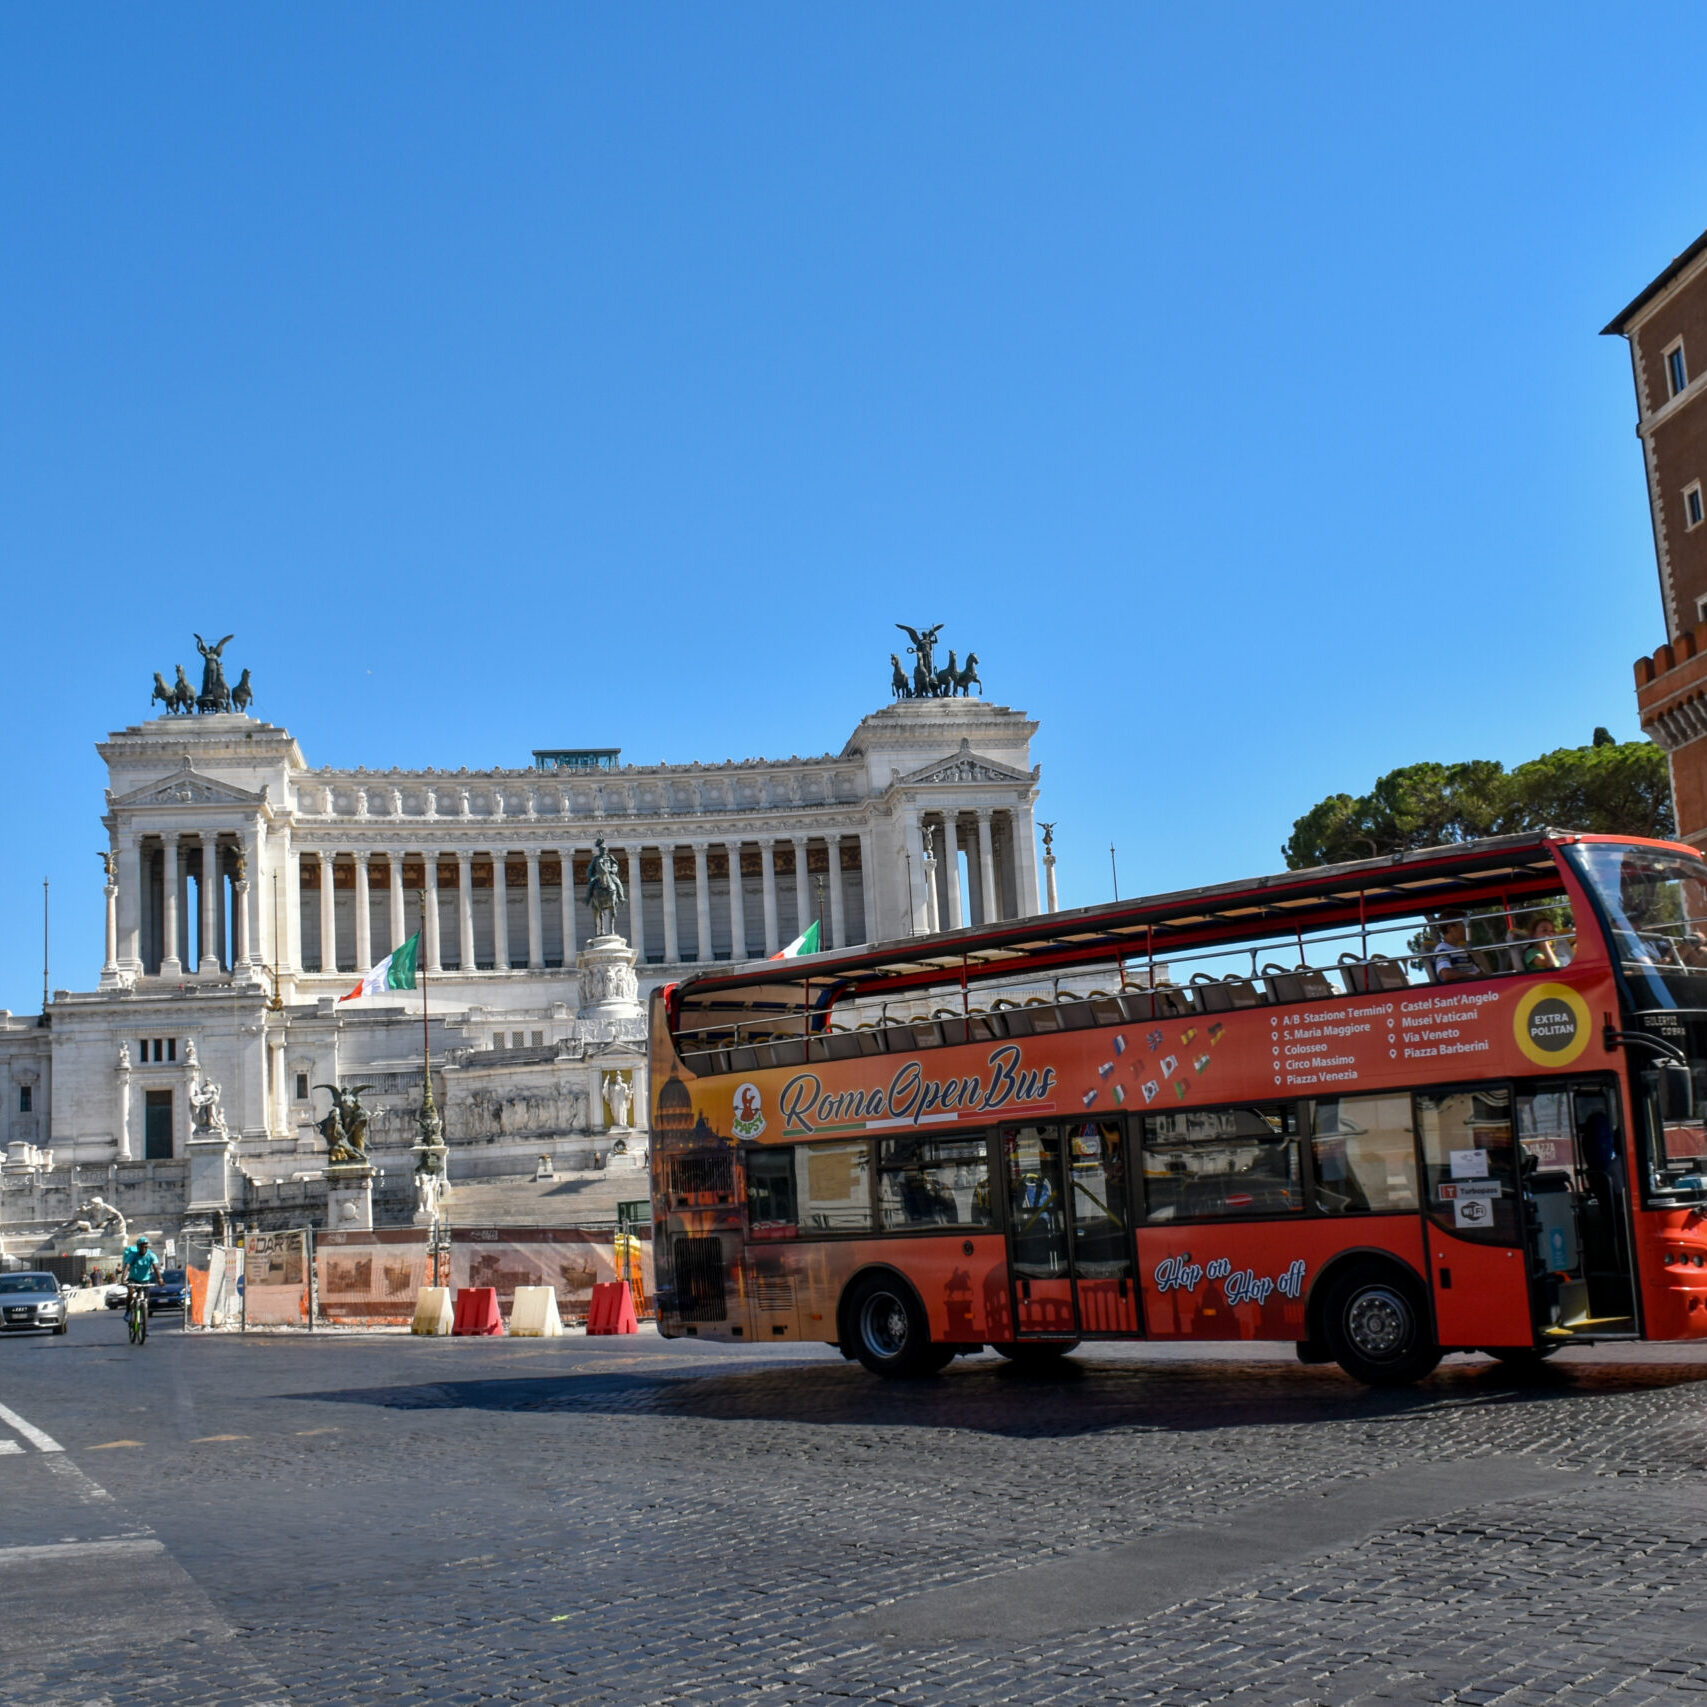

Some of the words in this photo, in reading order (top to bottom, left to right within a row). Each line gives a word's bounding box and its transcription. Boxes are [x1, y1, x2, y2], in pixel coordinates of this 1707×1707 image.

[1401, 998, 1432, 1012] Castel
[1283, 1015, 1300, 1026] A/B
[1304, 1011, 1346, 1023] Stazione
[1347, 1004, 1386, 1018] Termini
[1402, 1014, 1433, 1027] Musei
[1434, 1009, 1478, 1024] Vaticani
[1534, 1013, 1569, 1025] EXTRA
[1283, 1031, 1293, 1041] S.
[1294, 1028, 1321, 1039] Maria
[1323, 1023, 1371, 1036] Maggiore
[1403, 1032, 1420, 1043] Via
[1422, 1029, 1460, 1041] Veneto
[1531, 1024, 1574, 1037] POLITAN
[1284, 1044, 1328, 1055] Colosseo
[1404, 1048, 1438, 1058] Piazza
[1440, 1040, 1489, 1055] Barberini
[1286, 1059, 1310, 1070] Circo
[1312, 1055, 1355, 1067] Massimo
[1287, 1074, 1317, 1085] Piazza
[1319, 1069, 1358, 1082] Venezia
[780, 1073, 888, 1134] Roma
[888, 1060, 983, 1126] Open
[976, 1044, 1057, 1112] Bus
[1155, 1256, 1203, 1292] Hop
[1206, 1257, 1231, 1279] on
[1224, 1269, 1274, 1306] Hop
[1277, 1259, 1306, 1298] off
